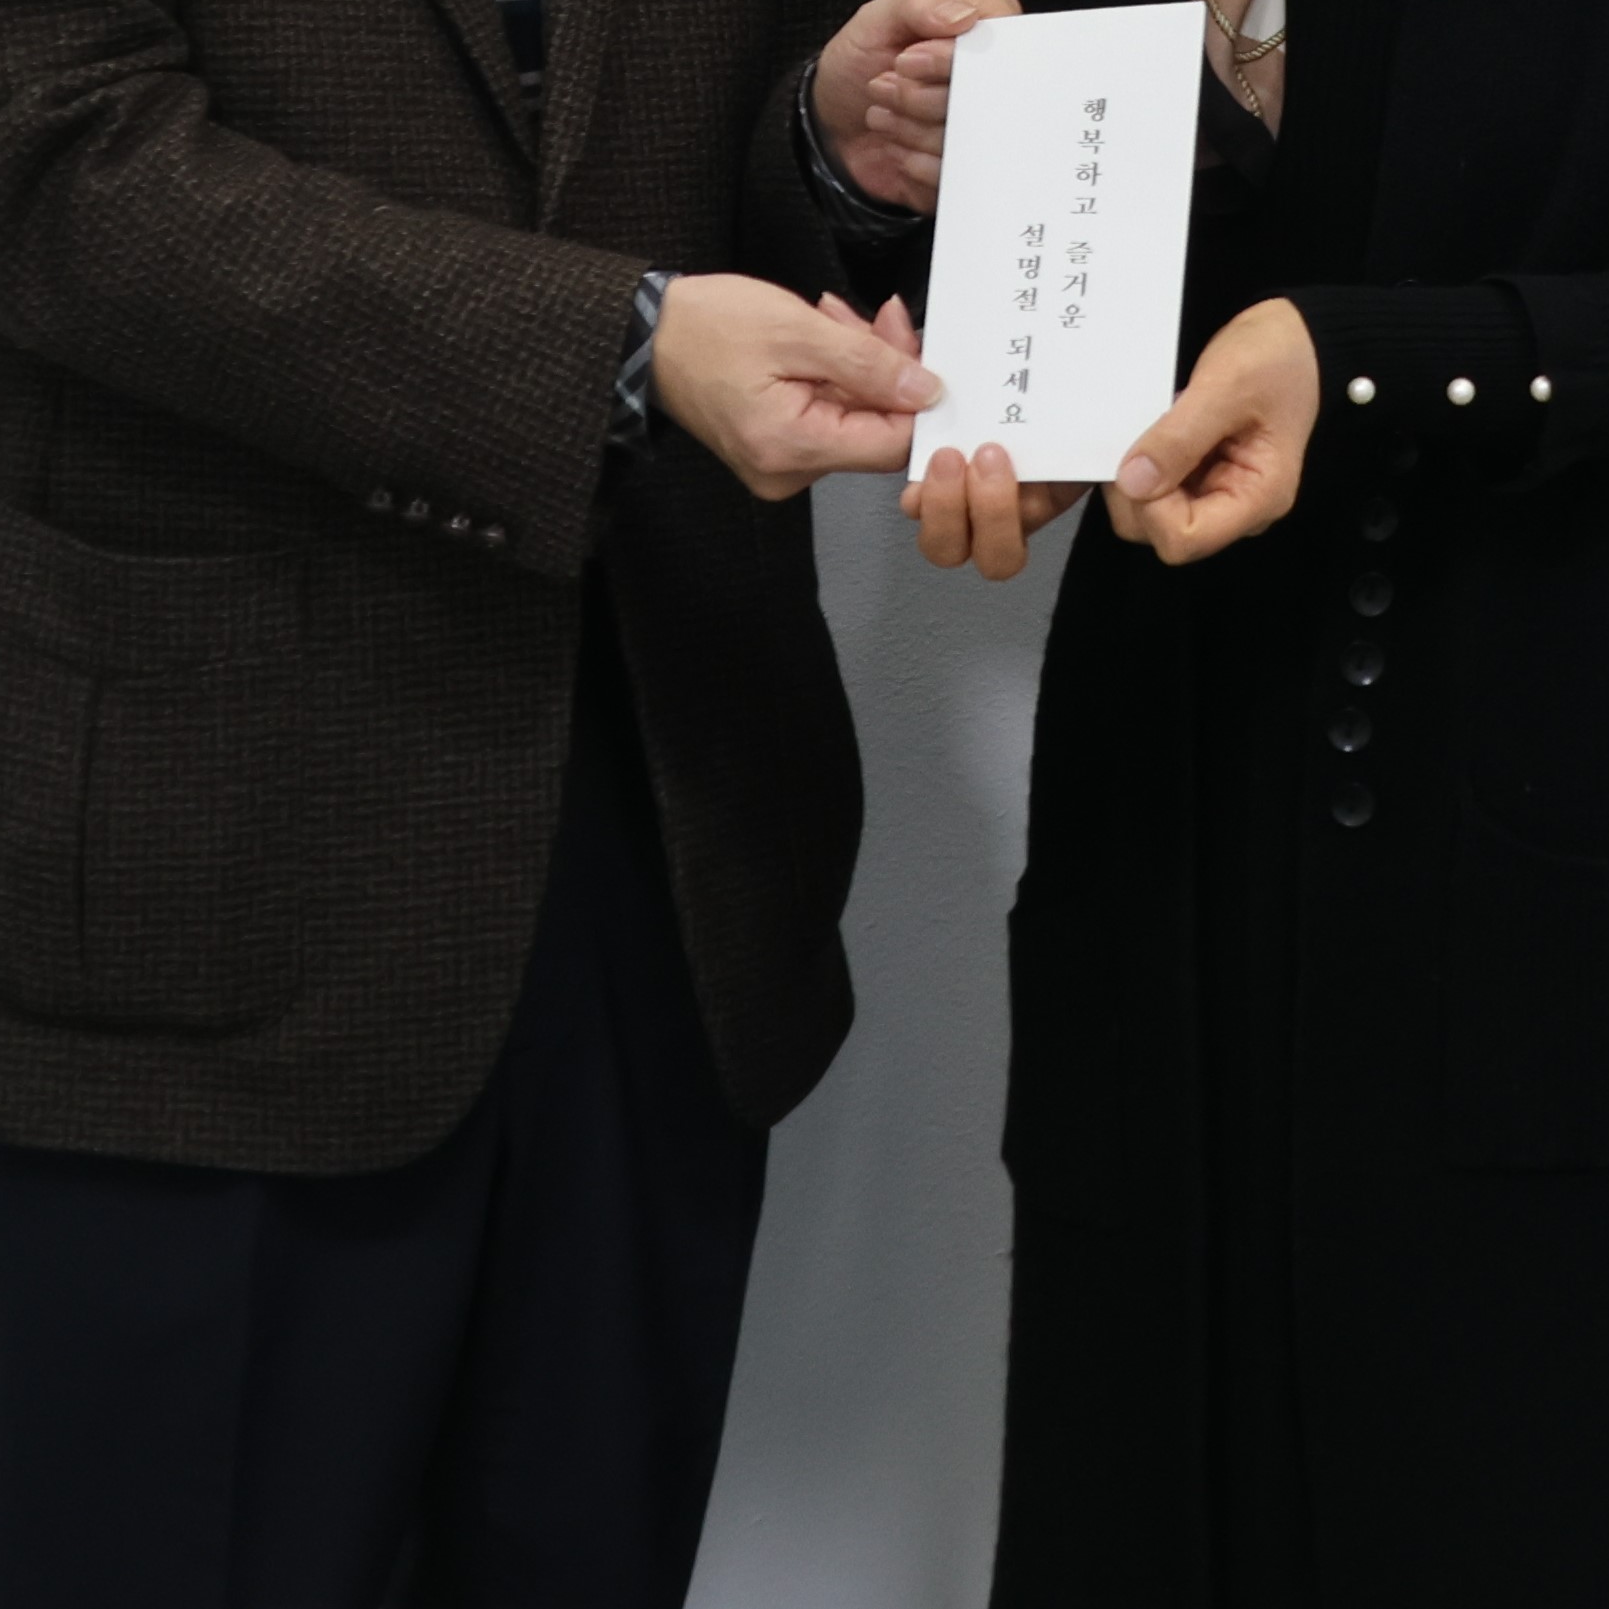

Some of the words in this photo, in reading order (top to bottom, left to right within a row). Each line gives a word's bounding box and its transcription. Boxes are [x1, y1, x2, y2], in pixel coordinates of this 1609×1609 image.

[1070, 96, 1107, 216] 행복하고
[1012, 222, 1046, 312] 설명절
[1058, 241, 1094, 330] 즐거운
[998, 335, 1033, 425] 되세요
